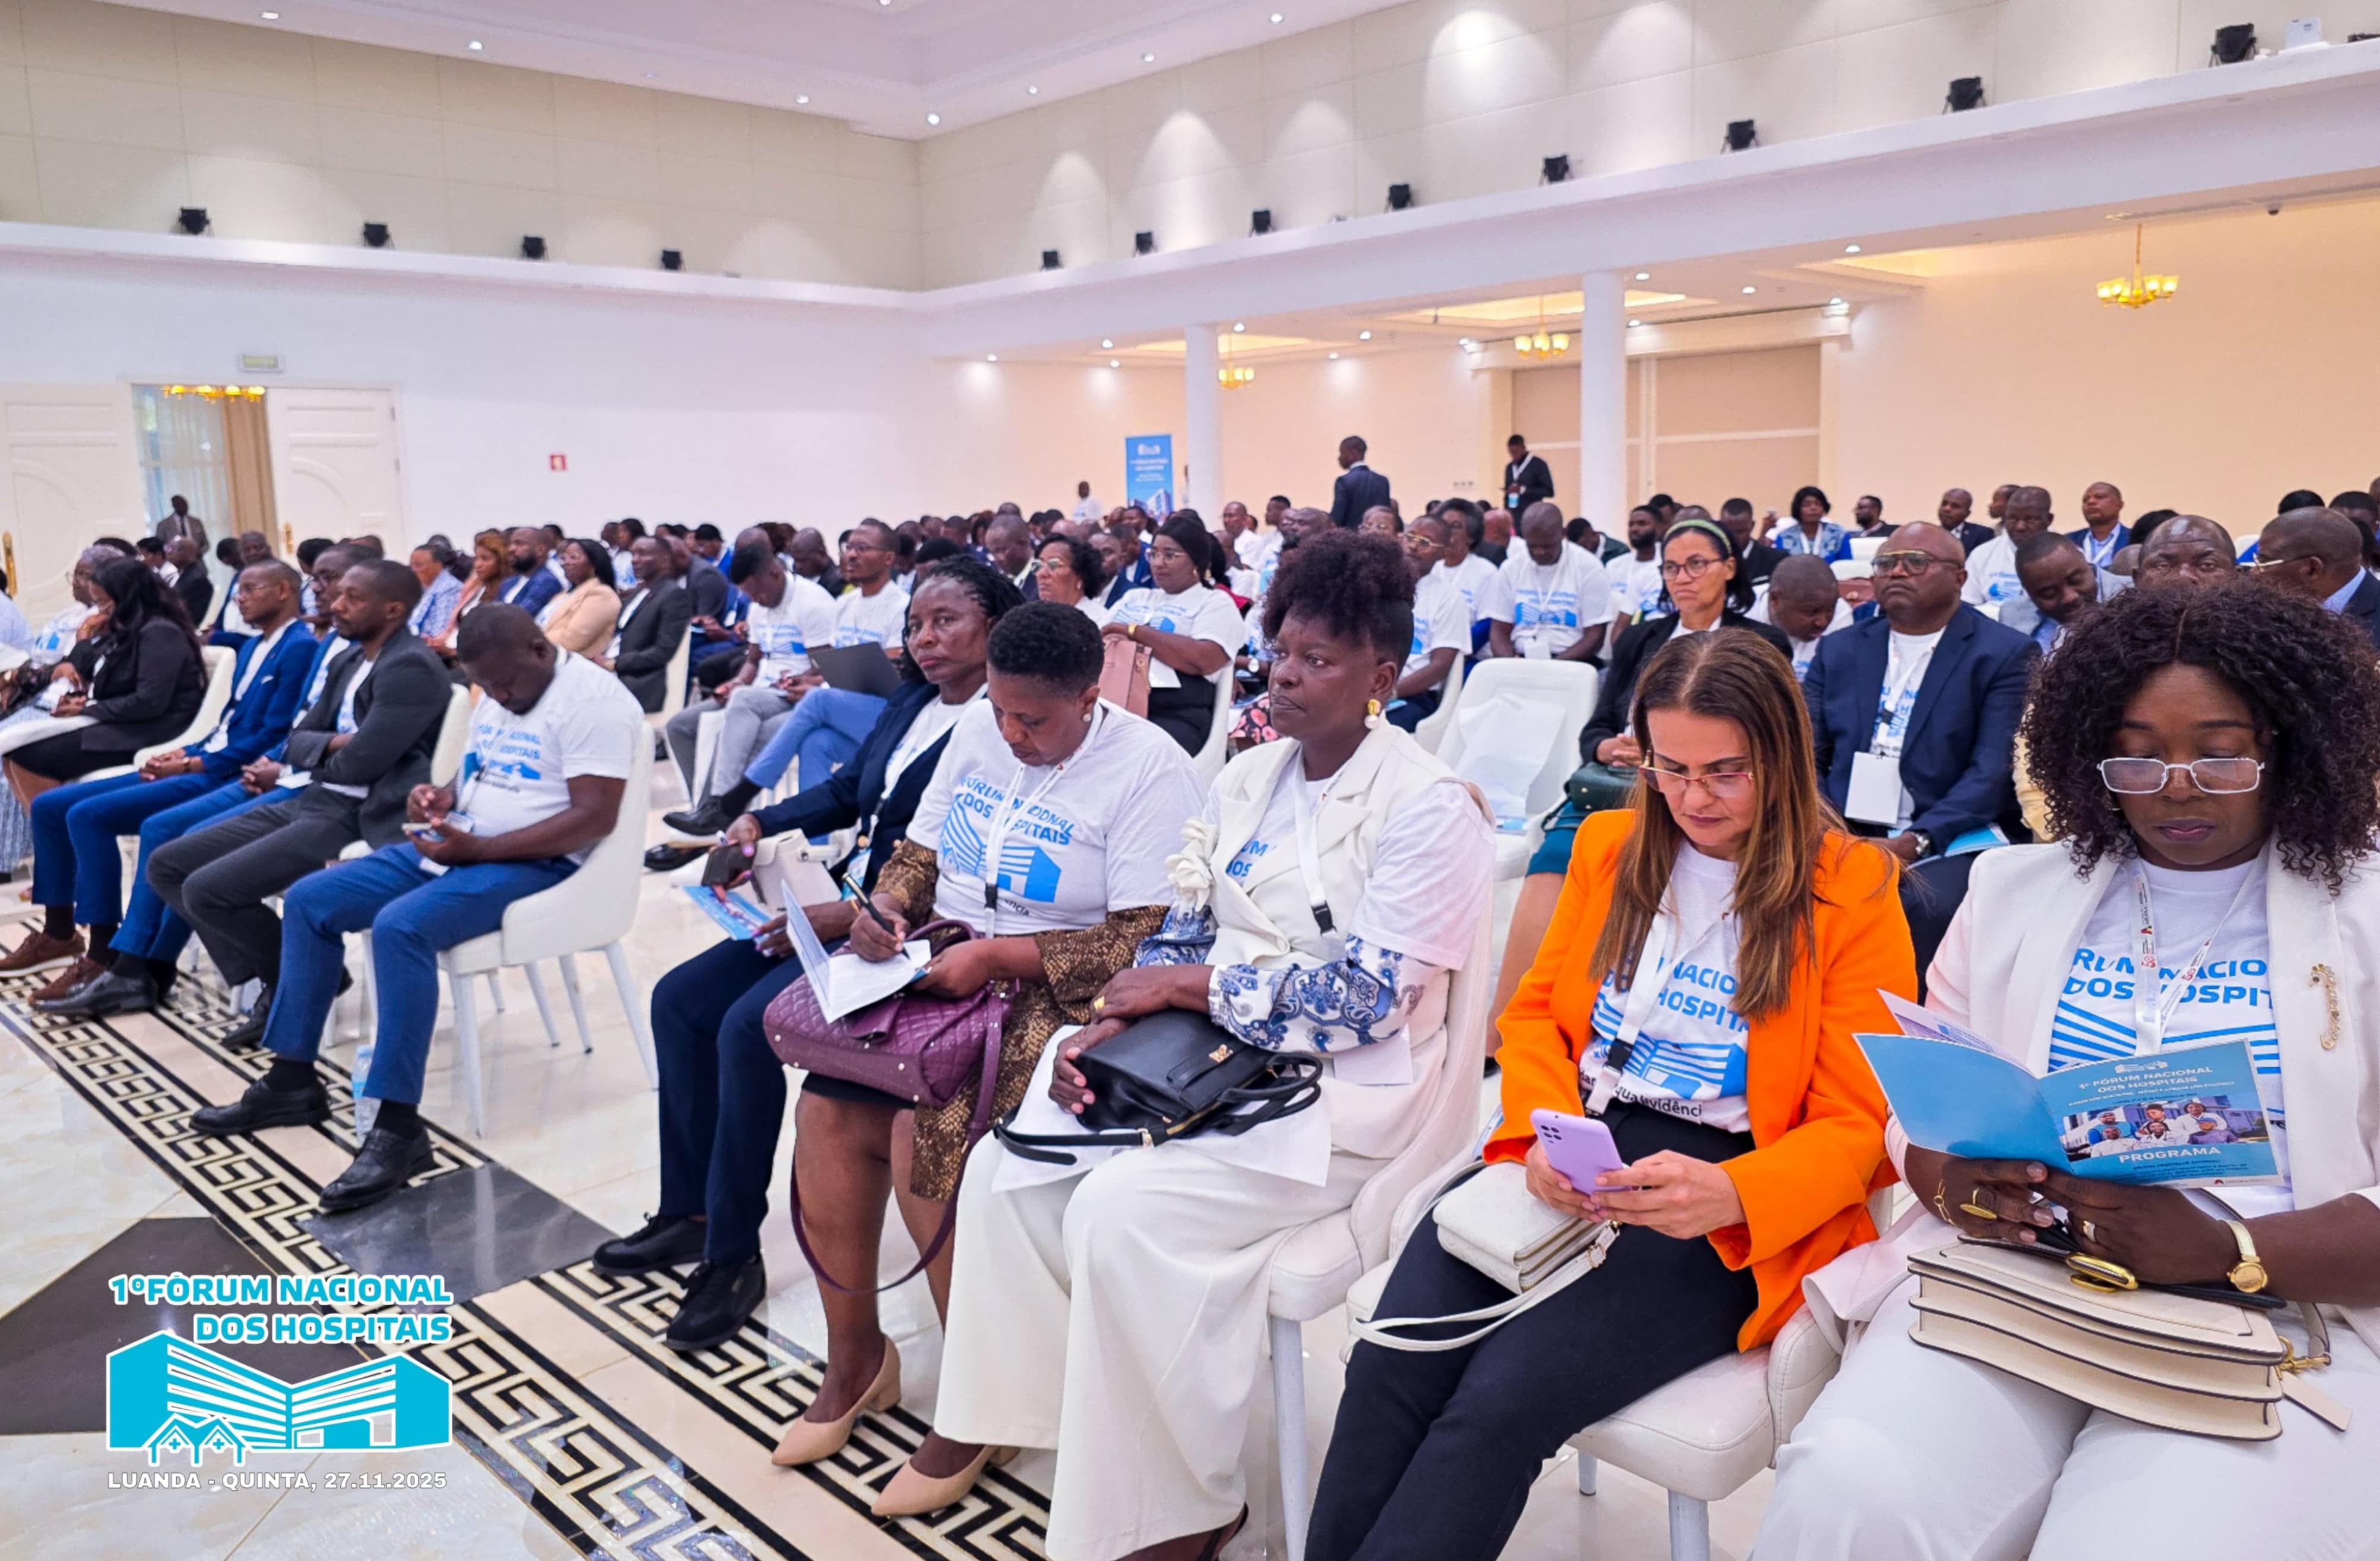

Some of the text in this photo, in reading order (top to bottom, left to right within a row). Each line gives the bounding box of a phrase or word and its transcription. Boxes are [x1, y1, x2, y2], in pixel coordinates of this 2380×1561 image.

[963, 792, 994, 819] DOS
[1673, 961, 1738, 995] NACIO
[2062, 976, 2135, 1000] DOS
[2093, 1074, 2140, 1086] FÓRUM
[2144, 1066, 2214, 1080] NACIONAL
[2128, 1077, 2198, 1089] HOSPITAIS
[2118, 1146, 2221, 1163] PROGRAMA
